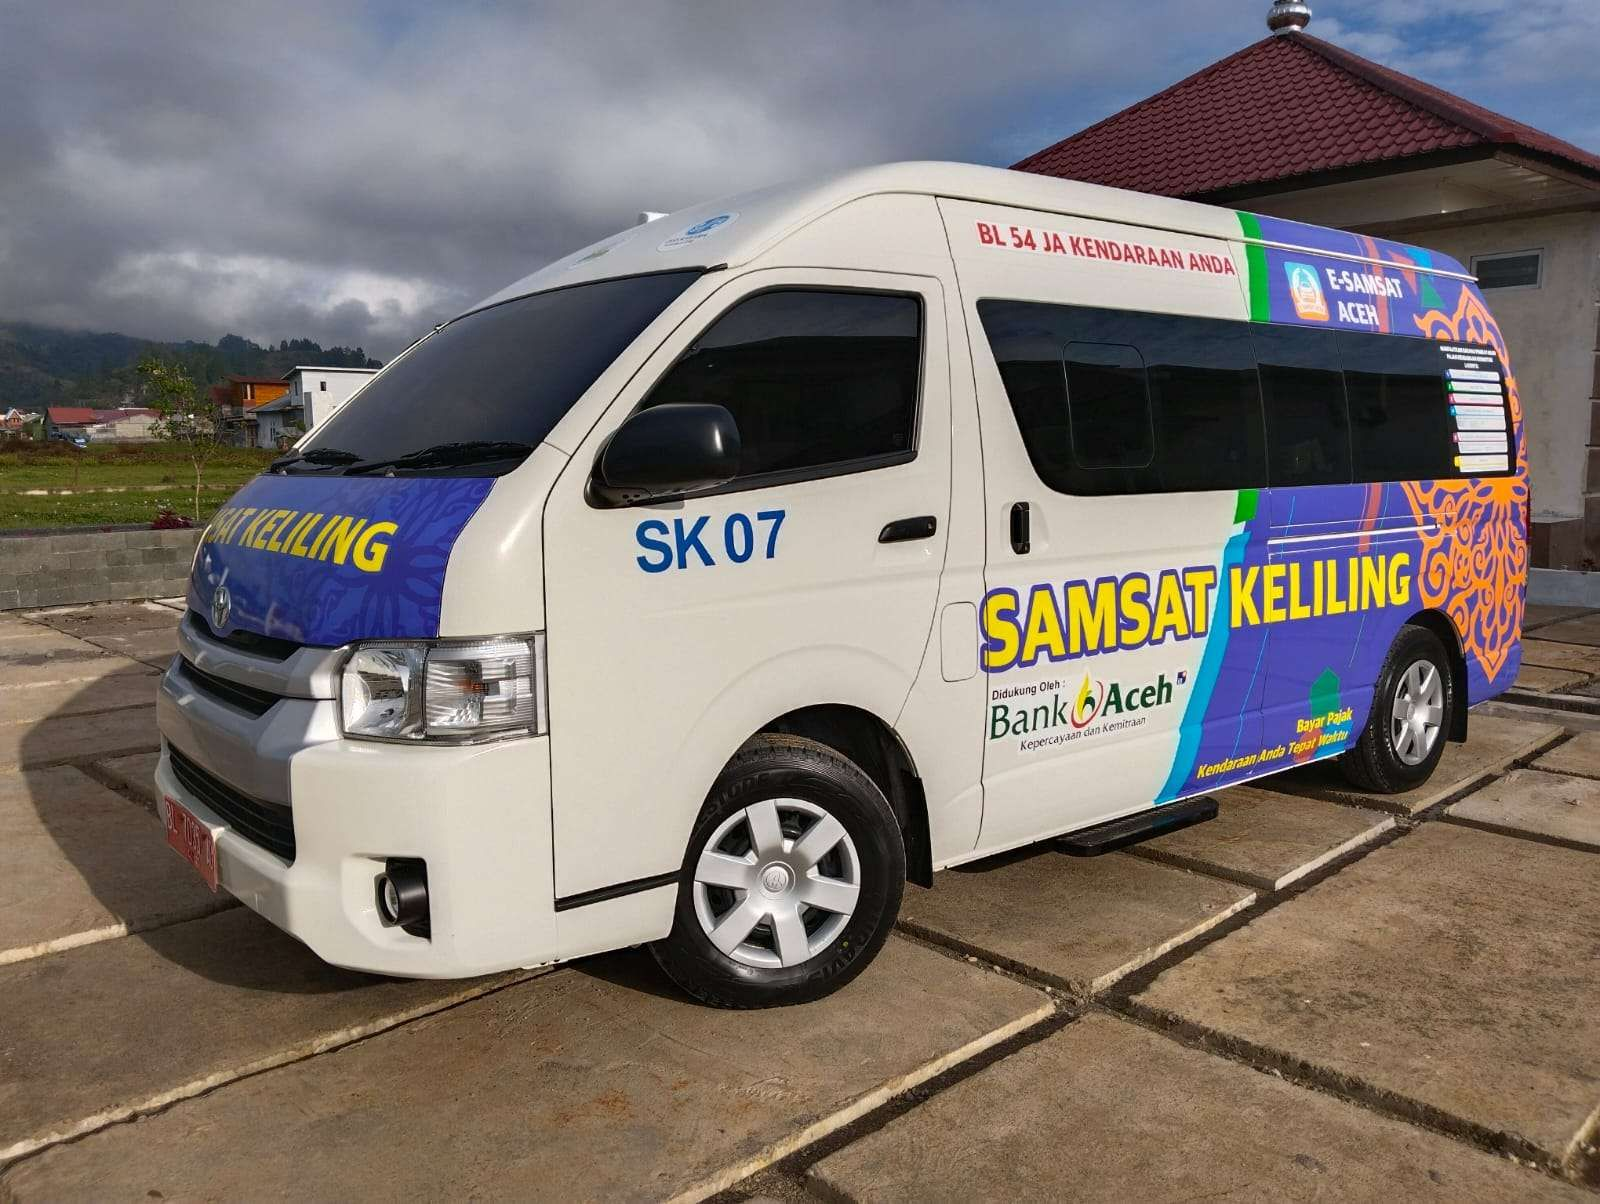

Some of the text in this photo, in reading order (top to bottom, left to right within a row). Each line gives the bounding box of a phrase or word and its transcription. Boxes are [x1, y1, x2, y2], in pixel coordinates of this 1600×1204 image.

[977, 222, 1235, 275] BL 54 JA KENDARAAN ANDA
[1325, 268, 1403, 298] E-SAMSAT
[1337, 301, 1379, 326] ACEH
[238, 508, 399, 572] KELILING
[635, 509, 786, 574] SK 07
[981, 552, 1411, 672] SAMSAT KELILING
[990, 674, 1173, 740] Bank Aceh
[992, 683, 1037, 700] Didukung
[1039, 680, 1060, 692] Oleh
[1020, 716, 1146, 751] Kepercayaan dan Kemitraan
[1296, 707, 1353, 733] Bayar Pajak
[1196, 730, 1348, 779] Kendaraan Anda Tepat Waktu
